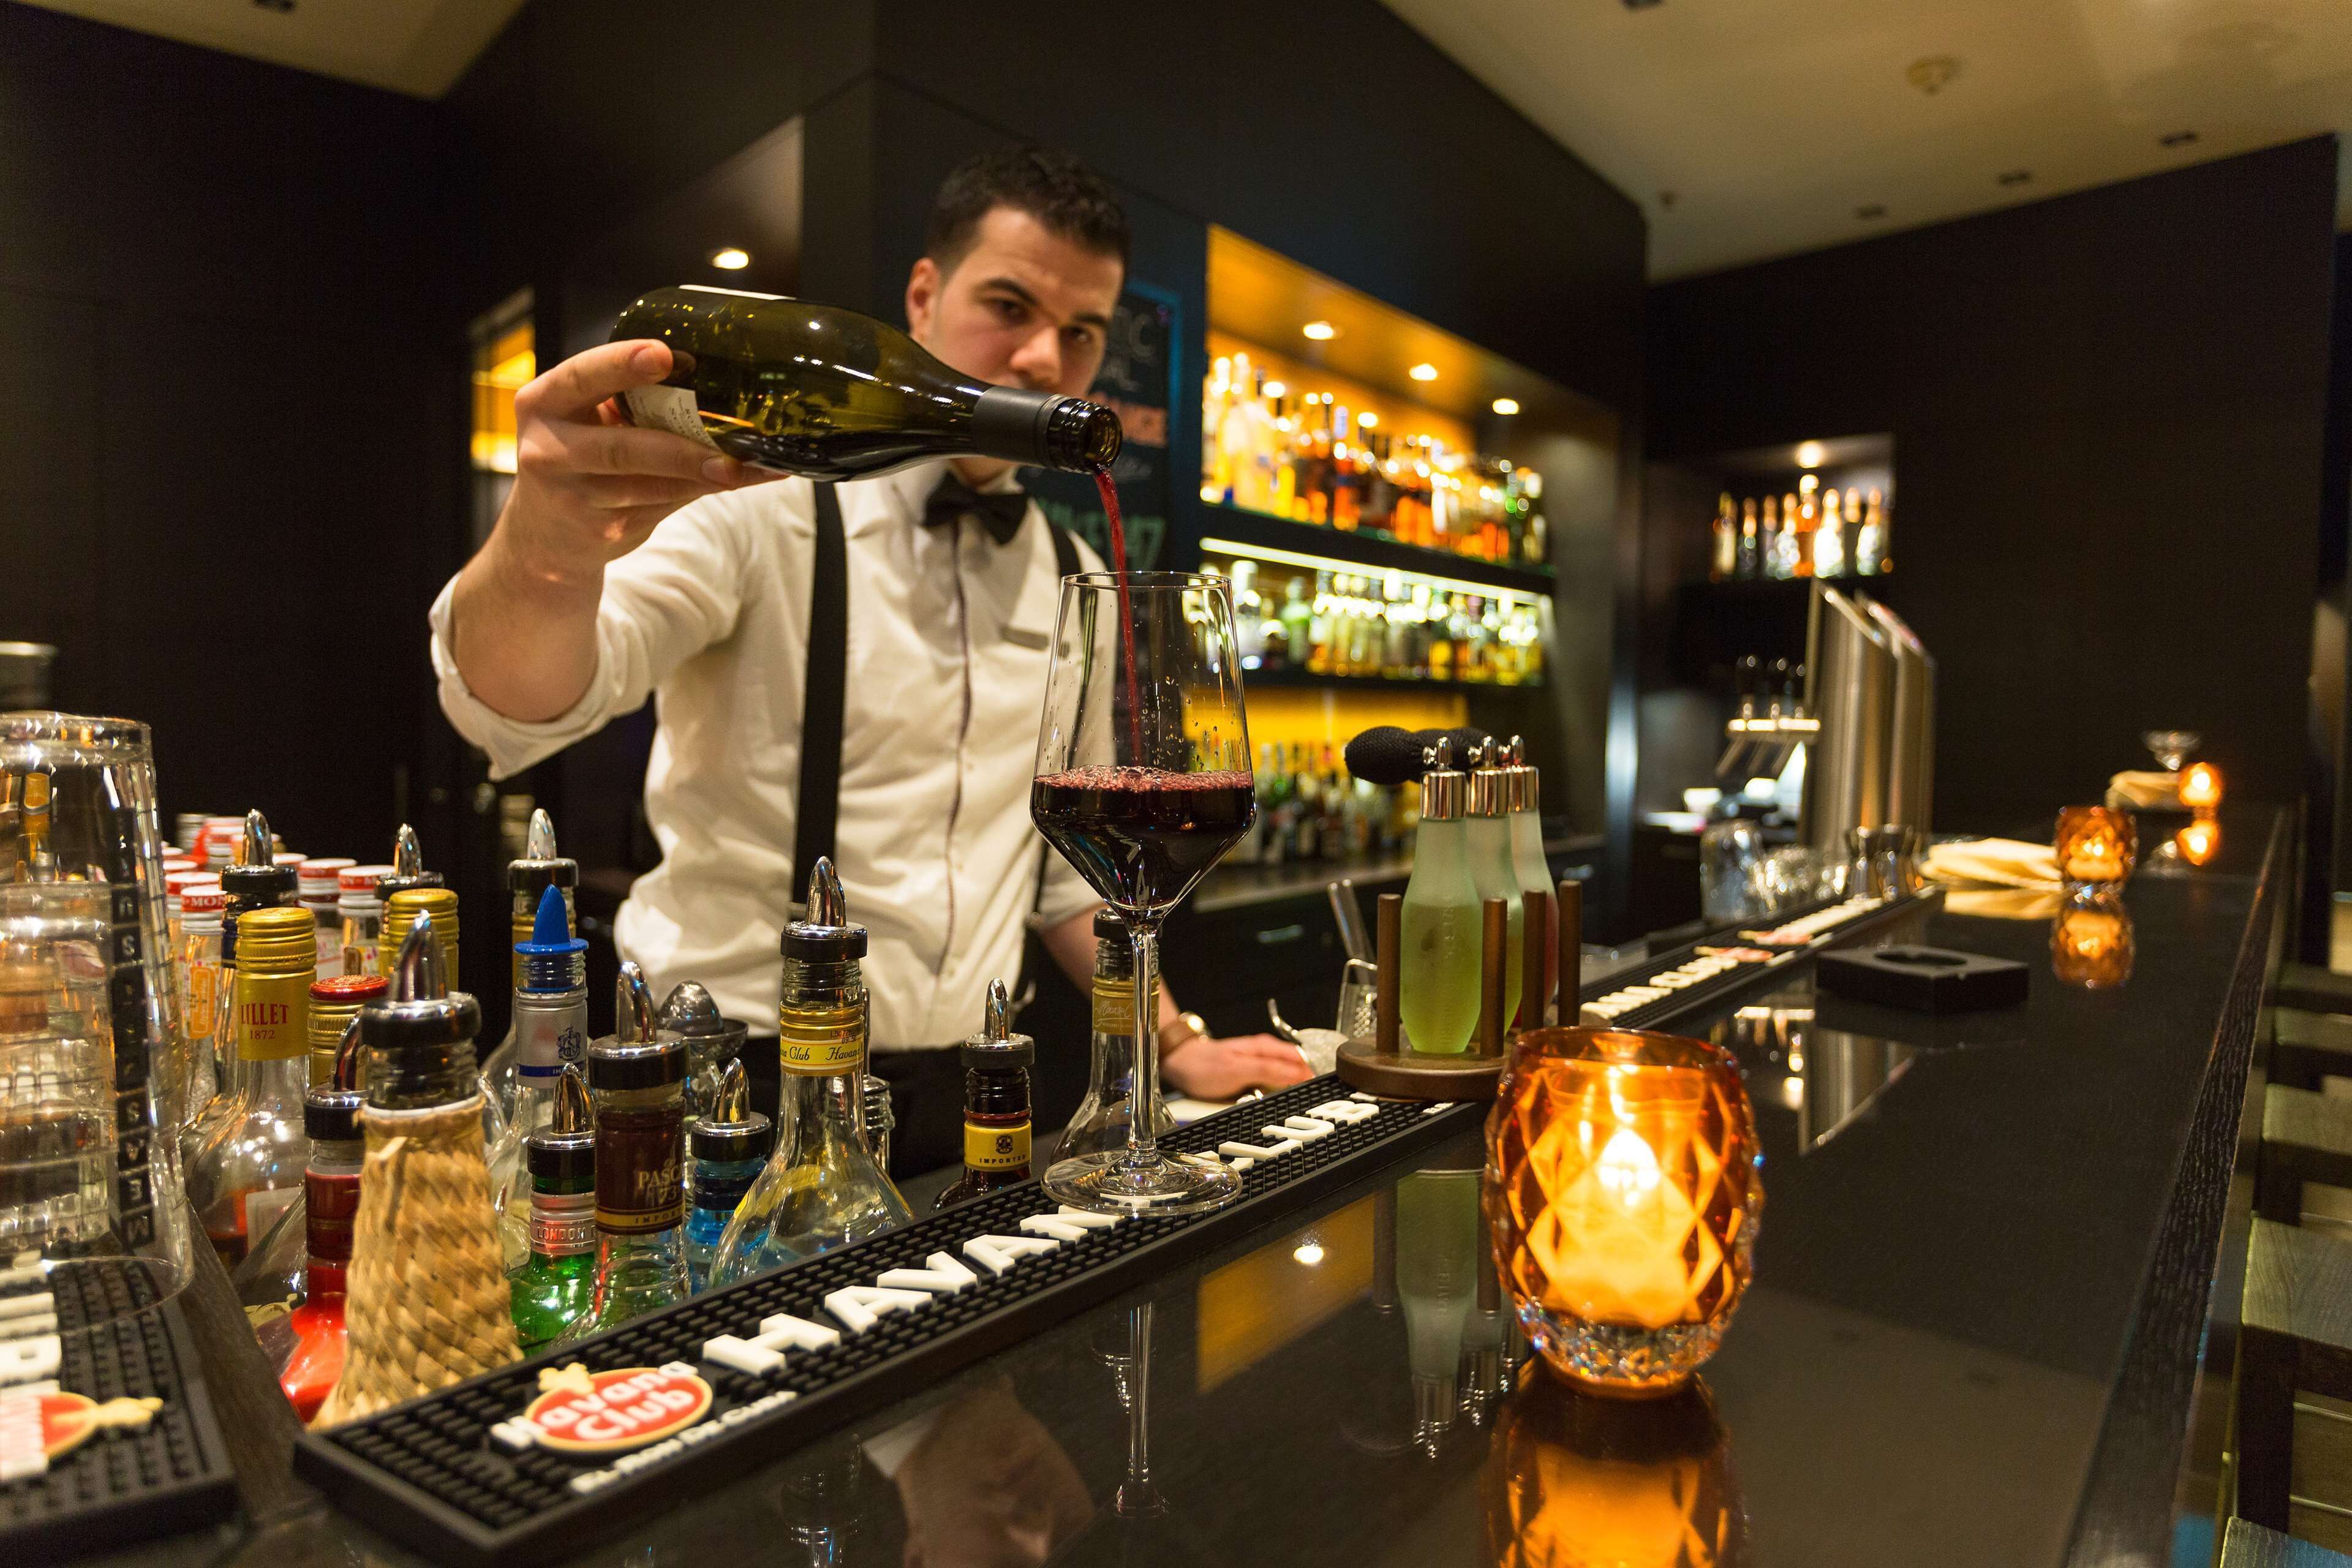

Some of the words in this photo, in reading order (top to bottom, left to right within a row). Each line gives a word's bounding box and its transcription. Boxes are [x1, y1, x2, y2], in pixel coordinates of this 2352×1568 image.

[192, 897, 225, 907] MON
[240, 1003, 289, 1025] LILLET
[250, 1029, 275, 1039] 1872
[789, 1046, 810, 1061] Club
[979, 1155, 1027, 1164] IMPORTED
[636, 1166, 681, 1189] PASC
[635, 1210, 677, 1224] IMPOR
[537, 1226, 586, 1240] LONDON
[491, 1360, 699, 1449] Havana
[575, 1389, 696, 1441] Club
